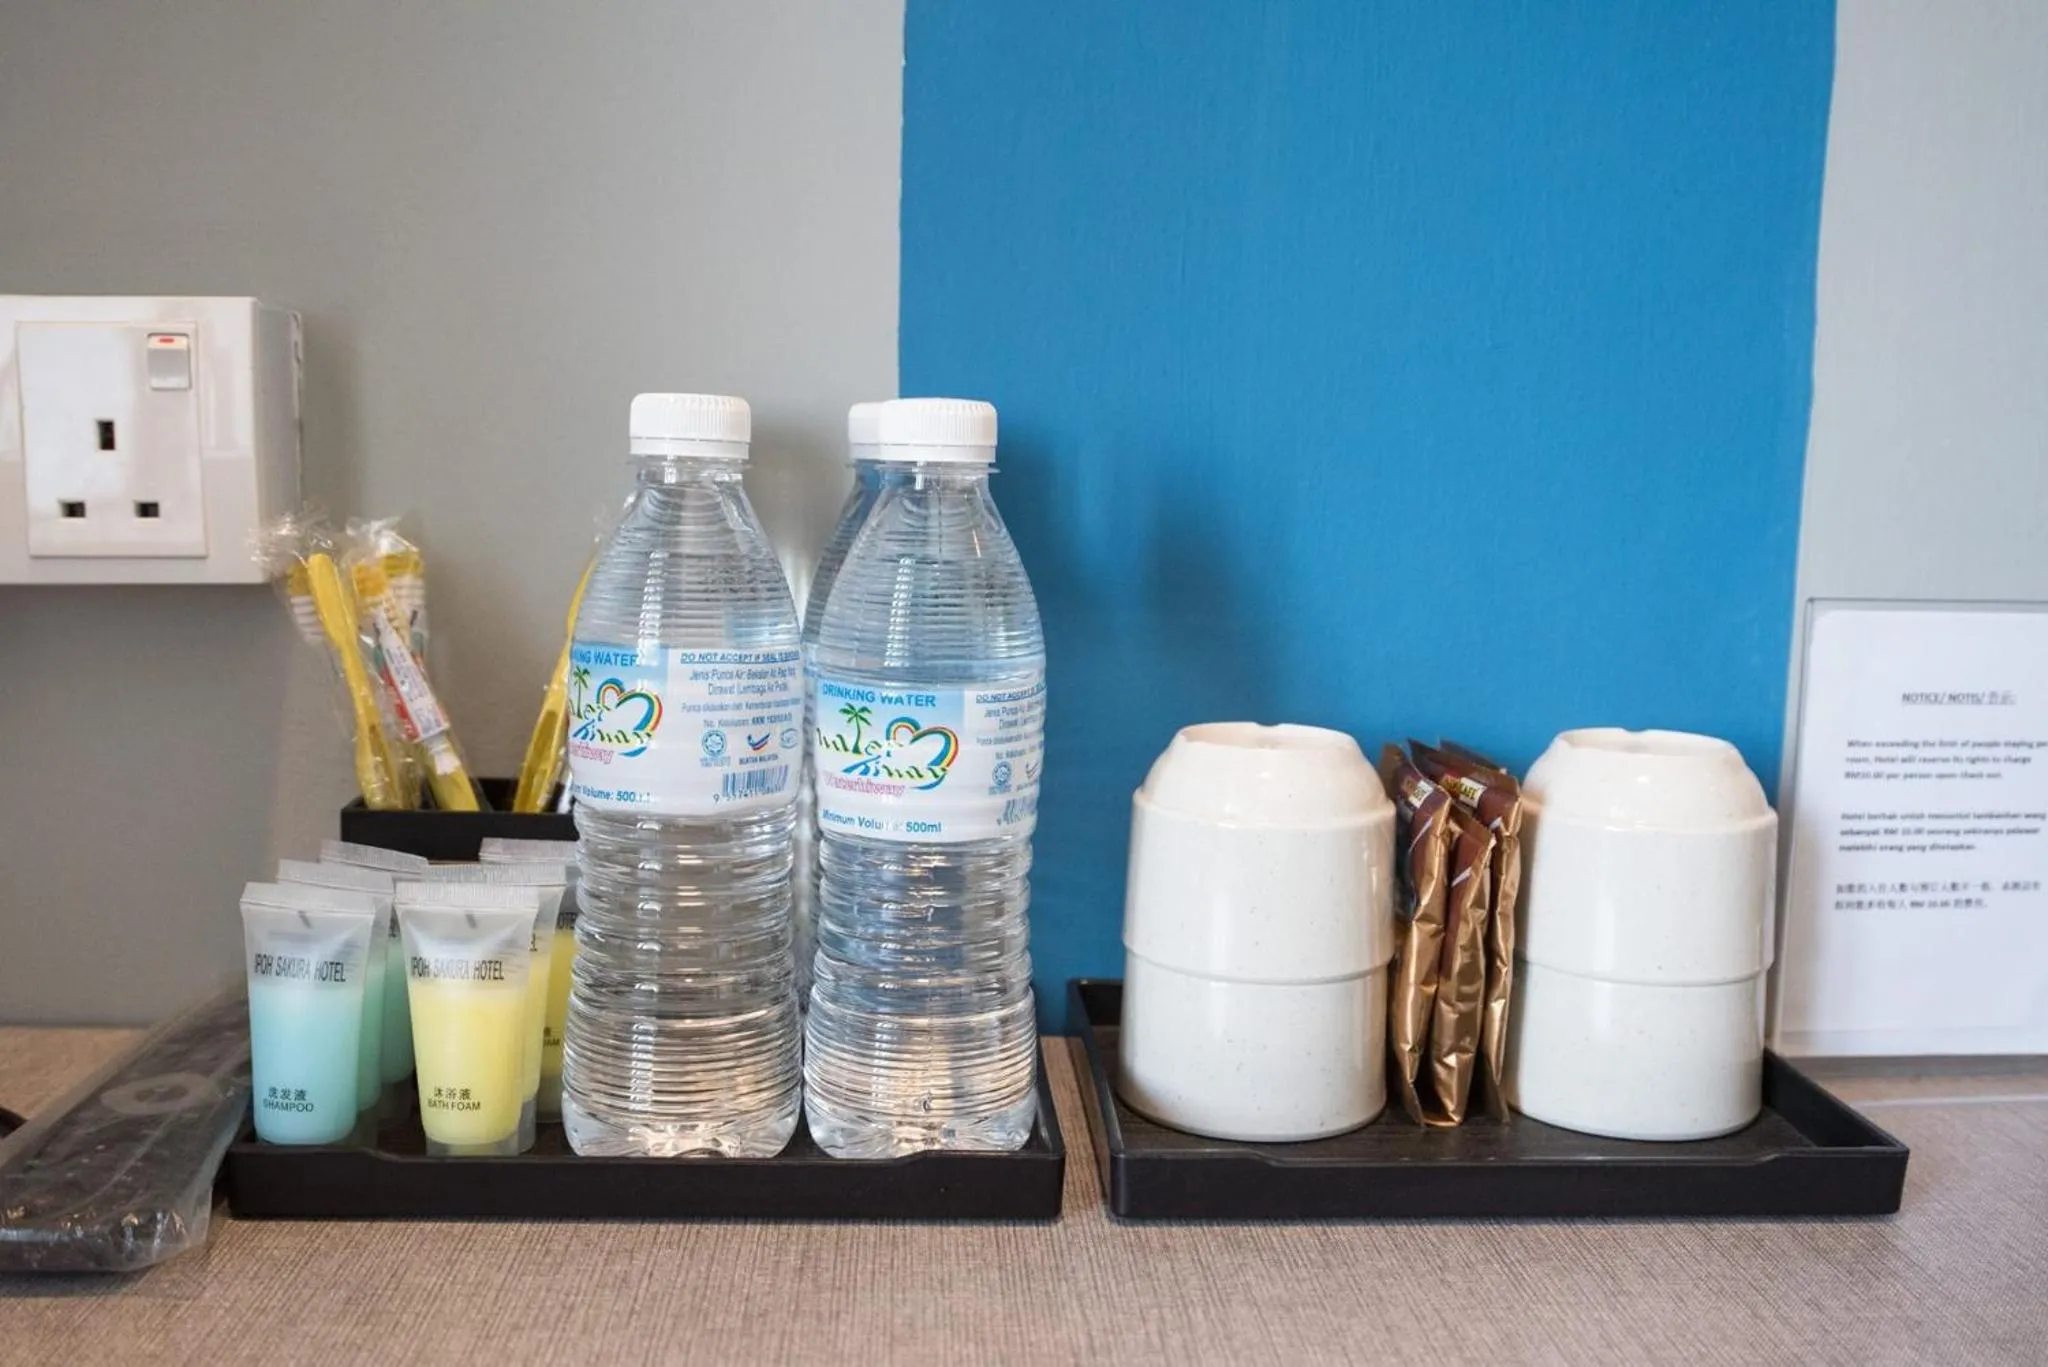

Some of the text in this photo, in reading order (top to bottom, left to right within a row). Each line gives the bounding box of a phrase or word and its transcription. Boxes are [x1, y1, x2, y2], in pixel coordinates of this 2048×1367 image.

[681, 652, 695, 663] DO
[698, 652, 718, 663] NOT
[720, 652, 752, 663] ACCEPT
[823, 683, 936, 708] DRINKING WATER
[906, 821, 942, 833] 500ml
[275, 955, 311, 980] SAKURA
[314, 960, 346, 982] HOTEL
[473, 959, 504, 981] HOTEL
[263, 1098, 314, 1112] SHAMPOO
[428, 1098, 481, 1111] BATH FOAM
